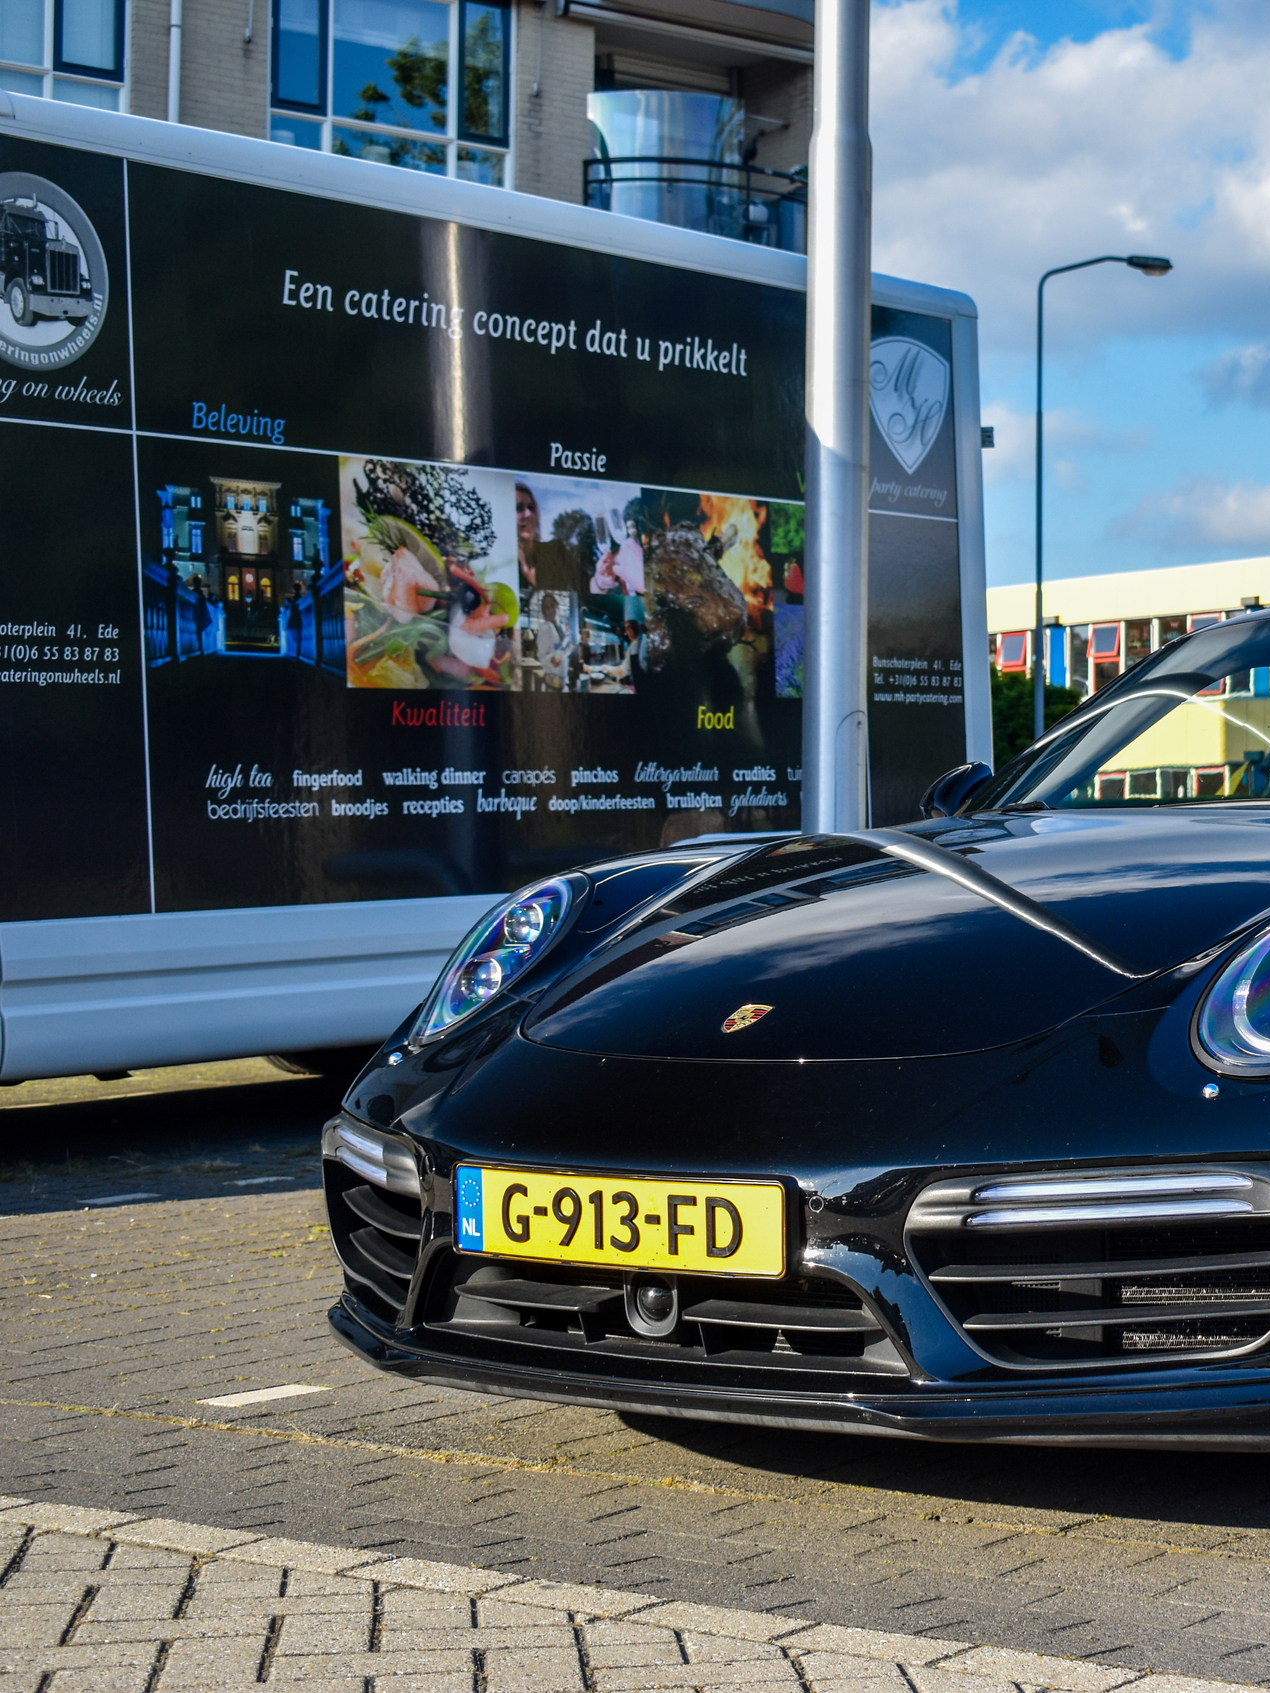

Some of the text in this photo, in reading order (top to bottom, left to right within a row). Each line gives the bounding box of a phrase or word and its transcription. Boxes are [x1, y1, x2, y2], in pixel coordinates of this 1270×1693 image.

[283, 269, 747, 377] Een catering concept dat u prikkelt
[0, 375, 123, 406] g on wheels
[192, 401, 286, 445] Beleving
[550, 442, 607, 472] Passie
[903, 484, 948, 509] catering
[97, 624, 119, 638] Ede
[43, 646, 59, 660] 55
[63, 647, 79, 660] 83
[84, 647, 99, 661] 87
[104, 648, 119, 661] 83
[872, 656, 928, 671] Bunschoterplein
[949, 660, 962, 671] Ede
[0, 668, 121, 686] ateringonwheels.nl
[889, 674, 917, 687] +31(0)6
[920, 676, 928, 686] 55
[931, 676, 940, 686] 83
[942, 677, 951, 687] 87
[953, 677, 962, 687] 83
[874, 691, 963, 706] www.mh-partycatering.com
[392, 700, 486, 727] Kwaliteit
[697, 705, 735, 729] Food
[205, 763, 244, 799] high
[249, 764, 274, 787] tea
[292, 769, 362, 791] fingerfood
[382, 767, 438, 789] walking
[440, 767, 486, 785] dinner
[502, 765, 556, 788] canapés
[570, 766, 619, 787] pinchos
[634, 761, 719, 792] bittergarnituur
[732, 765, 776, 781] crudités
[207, 799, 320, 823] bedrijfsfeesten
[331, 799, 389, 820] broodjes
[402, 796, 465, 818] recepties
[476, 788, 538, 821] barbeque
[548, 794, 655, 814] doop/kinderfeesten
[666, 791, 723, 812] bruiloften
[728, 786, 788, 817] galadiners
[462, 1217, 480, 1237] NL
[502, 1183, 743, 1258] G-913-FD
